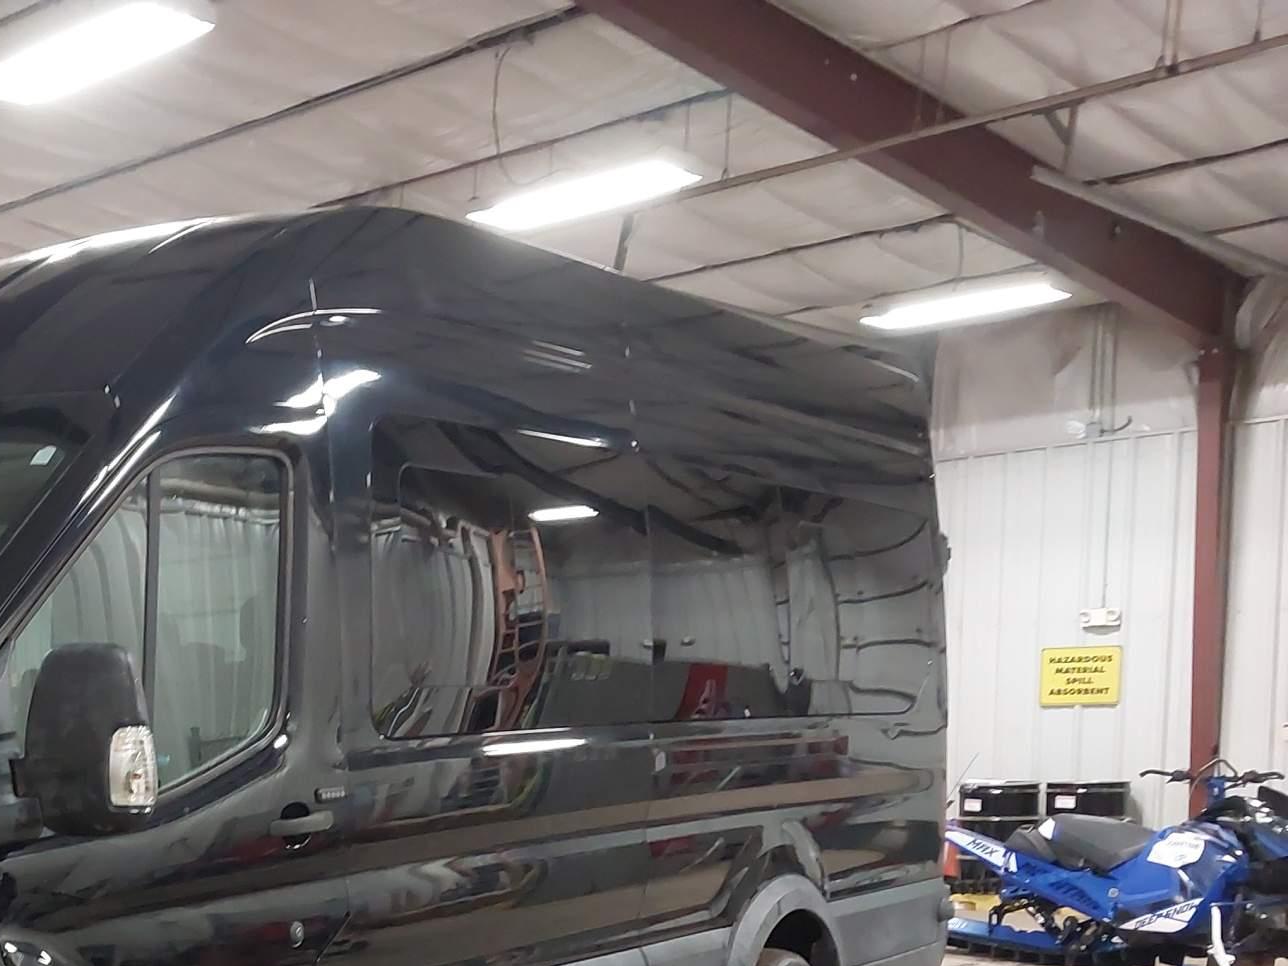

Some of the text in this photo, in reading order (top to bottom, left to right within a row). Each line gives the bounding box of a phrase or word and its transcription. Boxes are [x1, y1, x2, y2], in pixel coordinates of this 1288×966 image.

[1048, 654, 1113, 664] HAZARDOUS
[1054, 665, 1106, 674] MATERIAL
[1065, 677, 1094, 685] SPILL
[1048, 687, 1110, 696] ABSORBENT
